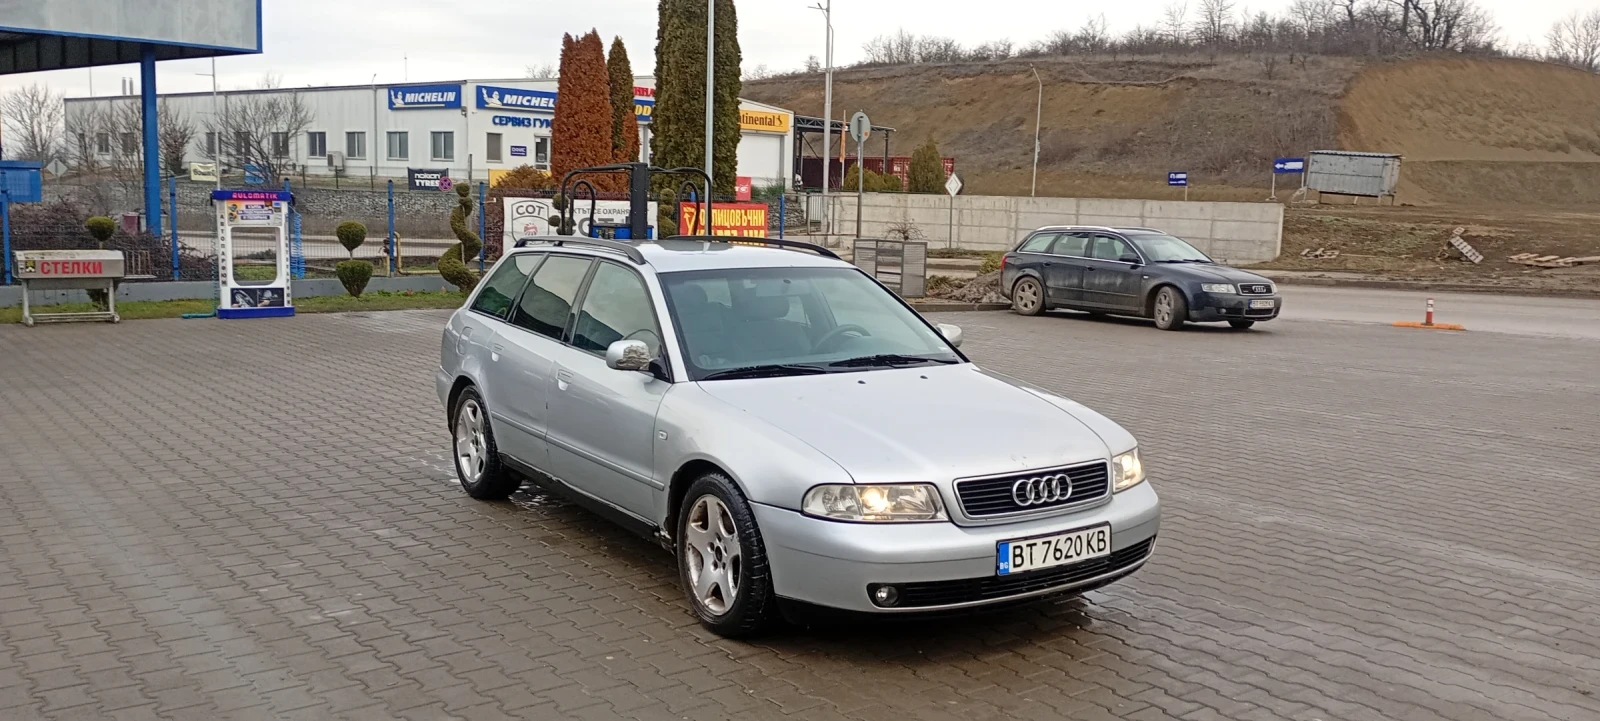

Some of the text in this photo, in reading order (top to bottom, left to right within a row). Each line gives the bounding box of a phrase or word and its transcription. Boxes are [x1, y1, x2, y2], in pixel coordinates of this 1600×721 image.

[404, 91, 457, 103] MICHELIN
[503, 93, 556, 108] MICHEL
[492, 115, 531, 128] СЕРВИЗ
[738, 112, 776, 127] ntinental
[414, 179, 441, 187] TYRES
[515, 204, 545, 216] СОТ
[699, 208, 765, 228] ОЛИЦОВЪЧНИ
[40, 261, 103, 275] СТЕЛКИ
[1012, 530, 1107, 568] BT 7620 KB
[1000, 562, 1009, 570] BG
